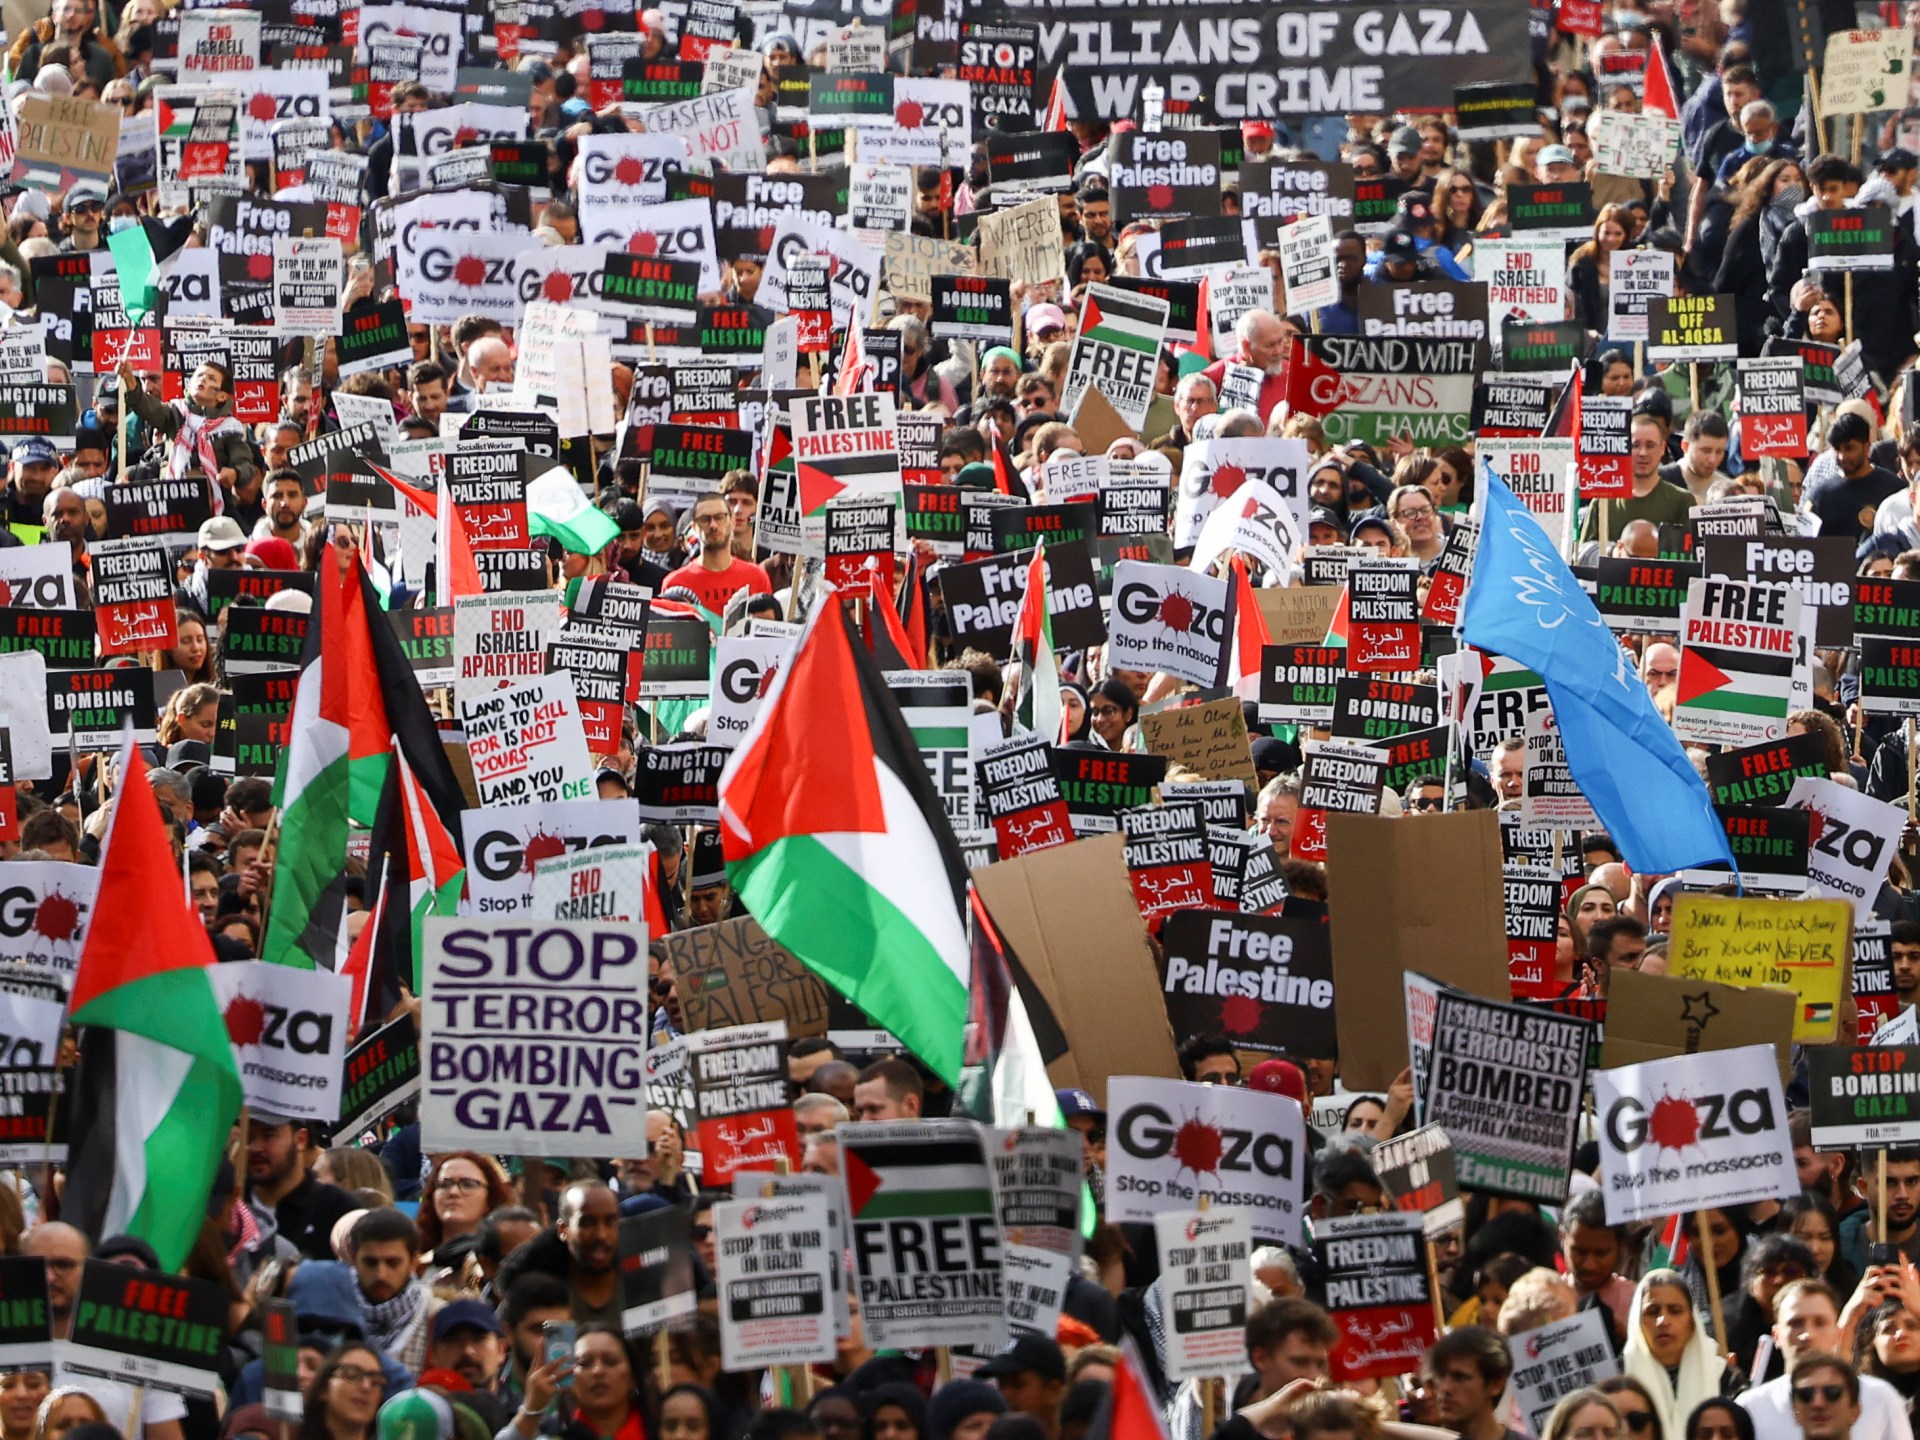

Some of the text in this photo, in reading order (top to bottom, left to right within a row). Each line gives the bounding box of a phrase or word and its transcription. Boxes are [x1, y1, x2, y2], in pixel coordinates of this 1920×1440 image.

[209, 25, 232, 41] END
[1276, 11, 1339, 58] OF
[1354, 9, 1489, 56] GAZA
[196, 38, 244, 56] ISRAELI
[961, 43, 1036, 69] STOP
[184, 54, 254, 71] APARTHEID
[959, 66, 1032, 86] ISRAEL'S
[1215, 64, 1384, 119] CRIME
[50, 105, 98, 126] FREE
[982, 98, 1030, 116] GAZA
[699, 120, 742, 152] NOT
[1132, 135, 1187, 162] Free
[1110, 161, 1216, 188] Palestine
[1270, 166, 1328, 191] Free
[746, 175, 805, 204] Free
[1242, 191, 1352, 219] Palestine
[278, 260, 338, 270] STOP THE WAR
[1506, 252, 1532, 270] END
[955, 277, 987, 291] STOP
[1493, 270, 1545, 286] ISRAELI
[942, 291, 1003, 307] BOMBING
[1214, 286, 1268, 298] STOP THE WAR
[956, 308, 989, 323] GAZA
[1668, 296, 1715, 314] HANDS
[1679, 314, 1704, 328] OFF
[1661, 327, 1724, 346] AL-AQSA
[1073, 339, 1155, 388] FREE
[1302, 338, 1477, 371] I STAND WITH
[675, 367, 732, 385] FREEDOM
[1744, 371, 1797, 389] FREEDOM
[673, 392, 736, 411] PALESTINE
[1310, 375, 1438, 409] GAZANS,
[1488, 387, 1545, 404] FREEDOM
[16, 403, 35, 418] ON
[805, 395, 882, 432] FREE
[1742, 395, 1802, 414] PALESTINE
[1484, 410, 1546, 428] PALESTINE
[288, 424, 375, 467] SANCTIONS
[457, 441, 513, 452] Socialist Worker
[682, 432, 724, 453] FREE
[798, 429, 895, 457] PALESTINE
[453, 454, 518, 474] FREEDOM
[654, 448, 748, 471] PALESTINE
[1511, 453, 1541, 473] END
[111, 482, 200, 504] SANCTIONS
[451, 482, 523, 502] PALESTINE
[1105, 490, 1161, 508] FREEDOM
[148, 500, 169, 517] ON
[464, 508, 512, 524] الحرية
[831, 505, 889, 526] FREEDOM
[133, 514, 187, 534] ISRAEL
[1102, 515, 1164, 534] PALESTINE
[1698, 518, 1758, 536] FREEDOM
[829, 531, 890, 552] PALESTINE
[99, 551, 162, 577] FREEDOM
[1359, 560, 1383, 568] Socialist
[1355, 573, 1410, 592] FREEDOM
[1630, 567, 1674, 587] FREE
[98, 578, 169, 603] PALESTINE
[1352, 601, 1414, 620] PALESTINE
[1702, 583, 1787, 625] FREE
[491, 608, 524, 632] END
[476, 631, 539, 654] ISRAELI
[560, 635, 617, 648] Socialist Worker
[1363, 627, 1403, 646] الحرية
[1687, 619, 1793, 653] PALESTINE
[553, 648, 620, 672] FREEDOM
[70, 673, 115, 691] STOP
[887, 675, 967, 686] Solidarity Campaign
[1368, 681, 1415, 701] STOP
[54, 689, 135, 711] BOMBING
[72, 708, 117, 726] GAZA
[465, 700, 568, 740] HAVE TO KILL
[1348, 698, 1434, 725] BOMBING
[1677, 715, 1763, 731] Palestine Forum Britain
[468, 720, 556, 756] FOR IS NOT
[1529, 735, 1551, 749] STOP
[474, 748, 534, 776] YOURS.
[1319, 744, 1378, 760] Socialist Worker
[1540, 749, 1553, 762] ON
[1741, 747, 1792, 777] FREE
[682, 767, 706, 784] ON
[1310, 758, 1378, 786] FREEDOM
[1530, 769, 1552, 781] FOR A
[562, 778, 592, 801] DIE
[1171, 786, 1232, 794] Socialist Worker
[1302, 786, 1377, 814] PALESTINE
[1122, 807, 1196, 835] FREEDOM
[1727, 817, 1768, 836] FREE
[1123, 838, 1204, 866] PALESTINE
[1140, 869, 1193, 893] الحرية
[479, 896, 517, 914] Stop
[1141, 889, 1203, 916] لفلسطين
[1208, 919, 1293, 964] Free
[1682, 940, 1710, 959] BUT
[1744, 941, 1772, 955] CAN
[1776, 937, 1835, 961] NEVER
[439, 928, 638, 982] STOP
[740, 952, 795, 985] FOR
[1682, 966, 1706, 981] SAY
[1770, 969, 1792, 983] DID
[1164, 957, 1335, 1009] Palestine
[431, 994, 643, 1036] TERROR
[1446, 1001, 1581, 1048] ISRAELI STATE
[1440, 1026, 1579, 1077] TERRORISTS
[1851, 1051, 1906, 1073] STOP
[242, 1061, 328, 1089] massacre
[429, 1042, 641, 1090] BOMBING
[1438, 1058, 1572, 1113] BOMBED
[698, 1080, 788, 1115] PALESTINE
[1854, 1095, 1908, 1118] GAZA
[455, 1088, 613, 1135] GAZA
[1866, 1128, 1880, 1139] FOA
[1612, 1150, 1783, 1192] Stop the massacre
[1116, 1174, 1293, 1213] Stop the massacre
[853, 1218, 1000, 1276] FREE
[1325, 1233, 1416, 1264] FREEDOM
[860, 1271, 1002, 1303] PALESTINE
[1325, 1275, 1428, 1308] PALESTINE
[124, 1279, 190, 1319] FREE
[77, 1300, 223, 1357] PALESTINE
